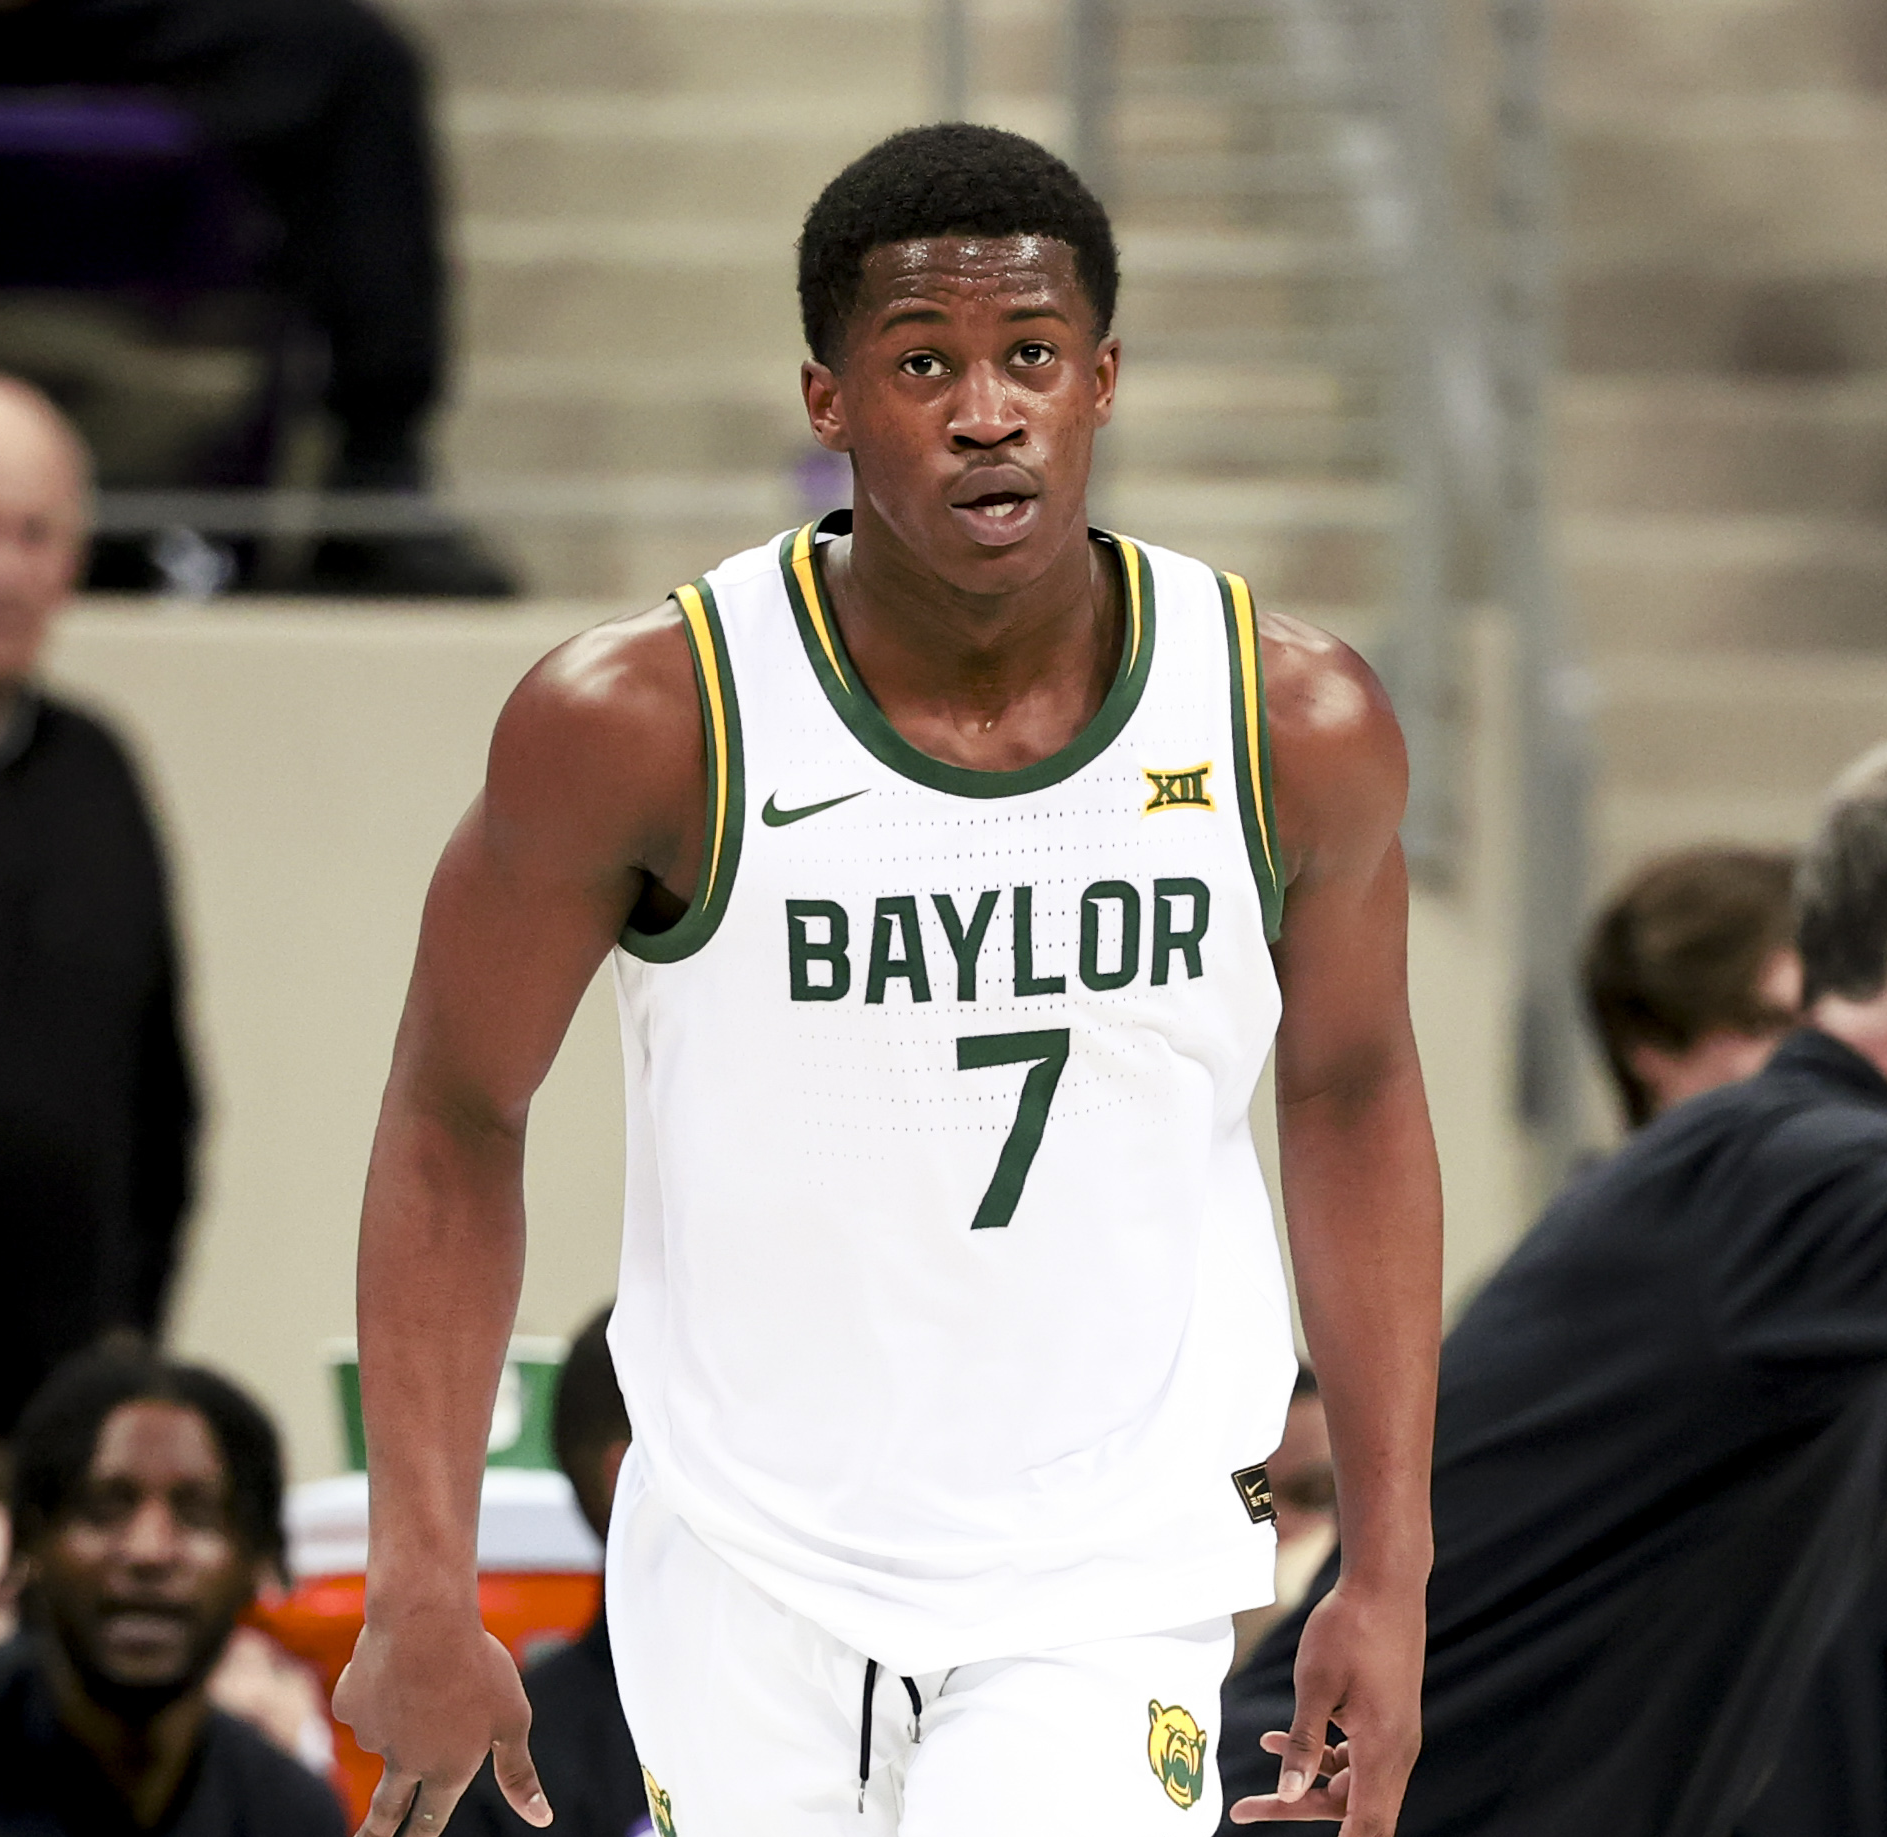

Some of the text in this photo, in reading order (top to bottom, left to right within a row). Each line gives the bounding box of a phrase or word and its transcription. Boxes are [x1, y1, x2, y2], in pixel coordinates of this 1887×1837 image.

[1146, 767, 1211, 811] XII
[785, 877, 1210, 1004] BAYLOR
[956, 1028, 1070, 1230] 7
